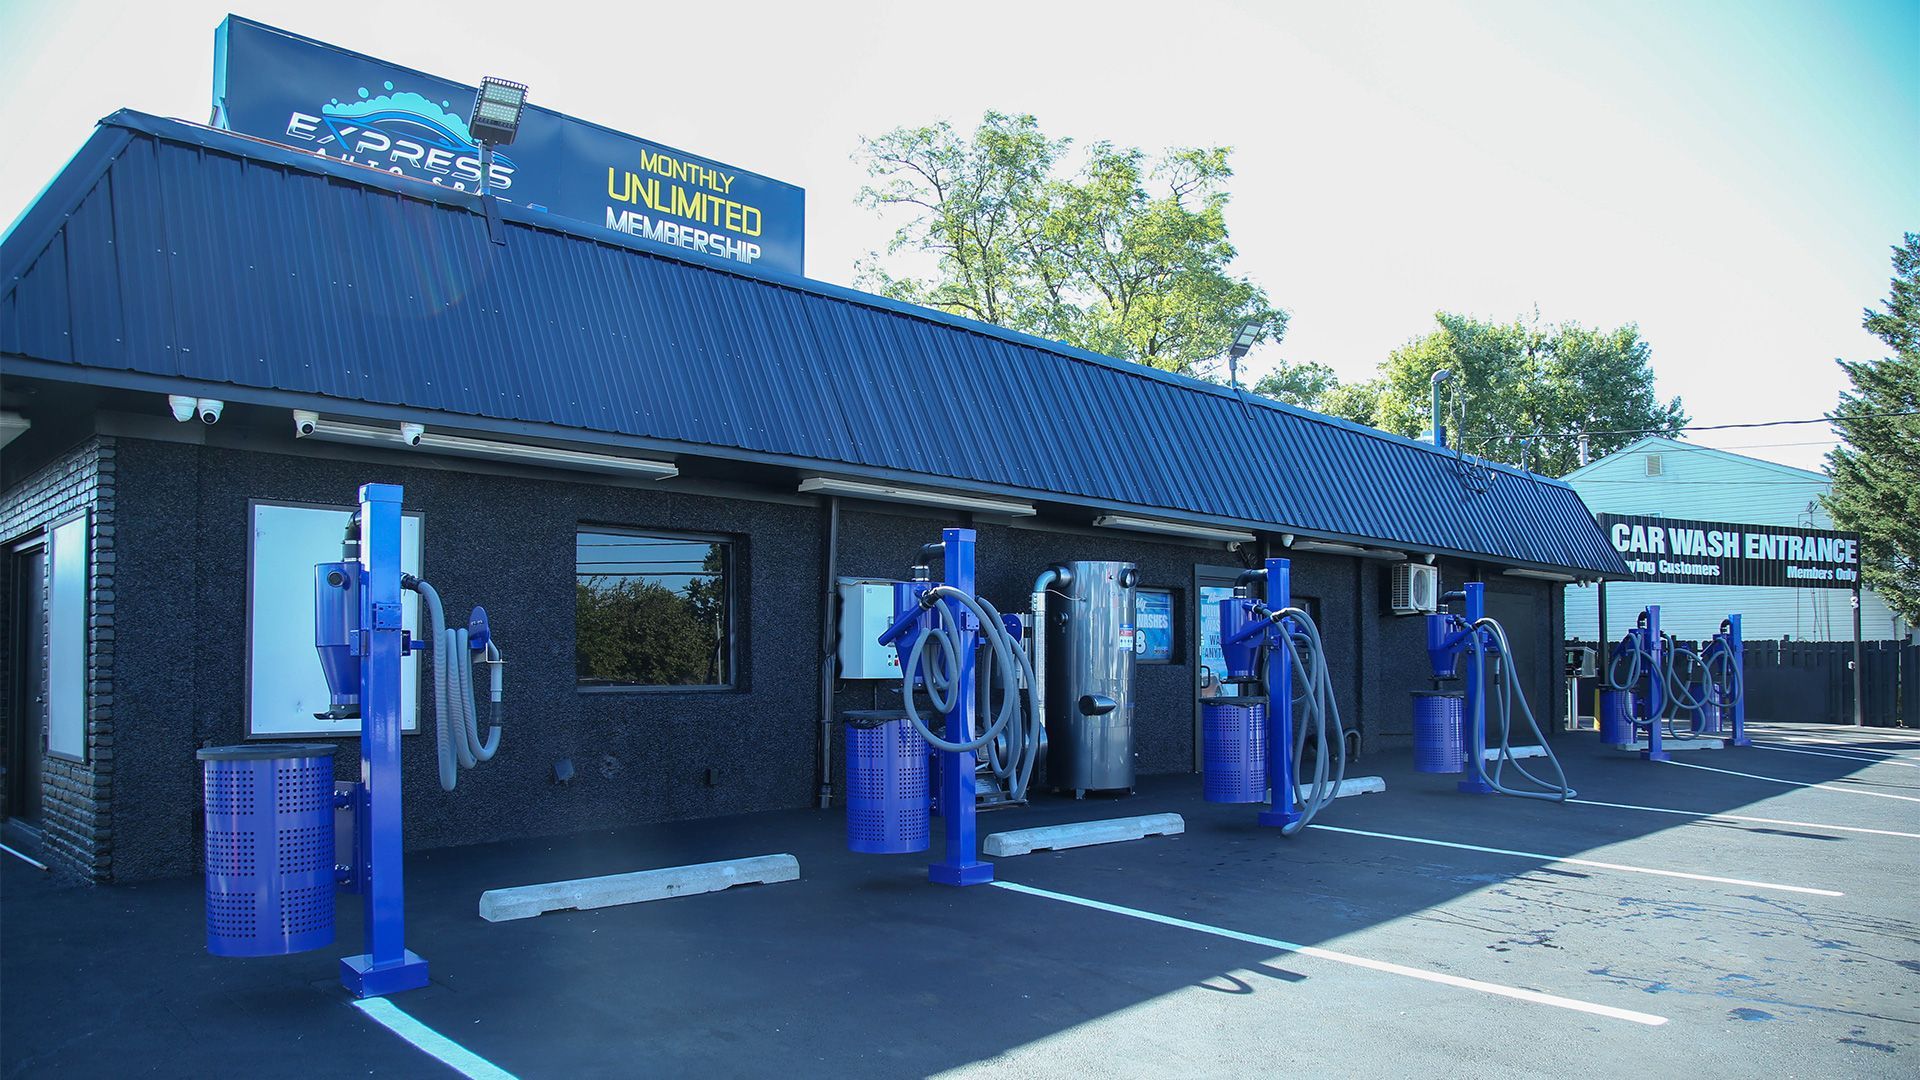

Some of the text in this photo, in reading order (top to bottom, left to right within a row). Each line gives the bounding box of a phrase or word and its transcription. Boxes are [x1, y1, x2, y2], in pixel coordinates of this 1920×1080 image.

[286, 112, 516, 190] EXPRESS
[640, 149, 736, 194] MONTHLY
[608, 167, 762, 237] UNLIMITED
[605, 206, 761, 264] MEMBERSHIP
[1611, 523, 1858, 564] CAR WASH ENTRANCE
[1624, 558, 1721, 577] ying Customers
[1786, 565, 1858, 583] Members Only
